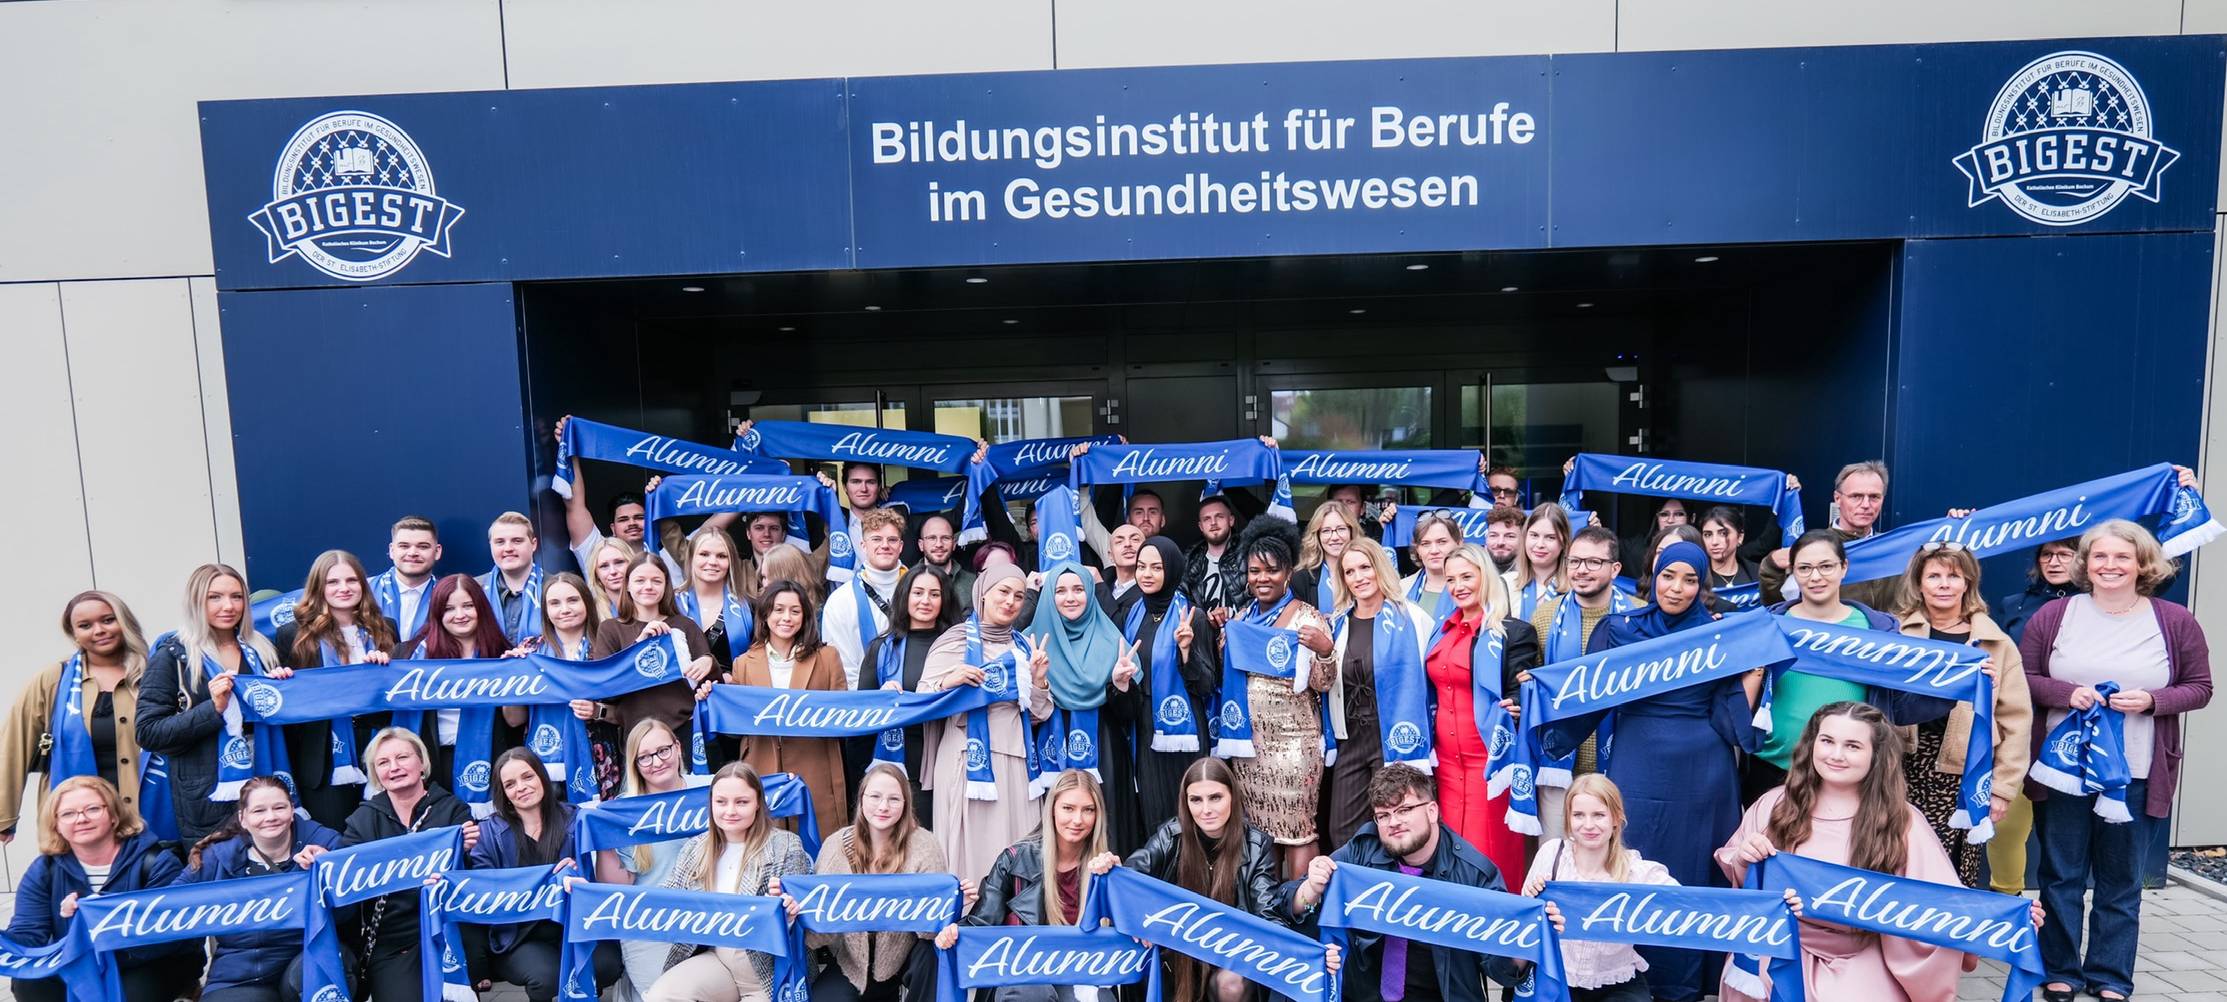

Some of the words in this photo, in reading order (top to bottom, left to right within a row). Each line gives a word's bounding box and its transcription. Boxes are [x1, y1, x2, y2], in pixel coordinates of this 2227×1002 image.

[1992, 73, 2034, 136] BILDUNGSINSTITUT
[2037, 63, 2052, 76] FÜR
[2055, 60, 2086, 69] BERUFE
[2088, 62, 2098, 70] IM
[2099, 66, 2144, 132] GESUNDHEITSWESEN
[281, 131, 317, 195] BILDUNGSINSTITUT
[316, 122, 331, 134] FÜR
[333, 119, 361, 128] BERUFE
[364, 121, 374, 130] IM
[375, 124, 426, 190] GESUNDHEITSWESEN
[872, 111, 1269, 168] Bildungsinstitut
[1283, 108, 1355, 151] für
[1371, 102, 1535, 148] Berufe
[1984, 134, 2149, 183] BIGEST
[277, 192, 433, 239] BIGEST
[929, 182, 986, 222] im
[1004, 172, 1478, 219] Gesundheitswesen
[2014, 194, 2027, 207] DER
[2041, 192, 2114, 218] ELISABETH-STIFTUNG
[312, 251, 325, 263] DER
[627, 435, 753, 475] Alumni
[832, 432, 951, 464] Alumni
[1113, 449, 1228, 477] Alumni
[1291, 453, 1411, 480] Alumni
[677, 478, 802, 508] Alumni
[1613, 462, 1746, 497] Alumni
[386, 667, 548, 702] Alumni
[1553, 634, 1727, 710] Alumni
[754, 694, 899, 728] Alumni
[88, 887, 293, 942] Alumni
[584, 892, 756, 937] Alumni
[798, 883, 960, 922] Alumni
[1344, 880, 1543, 948] Alumni
[1581, 892, 1792, 948] Alumni
[1811, 875, 2033, 953] Alumni
[968, 936, 1152, 977] Alumni
[1142, 901, 1325, 994] Alumni
